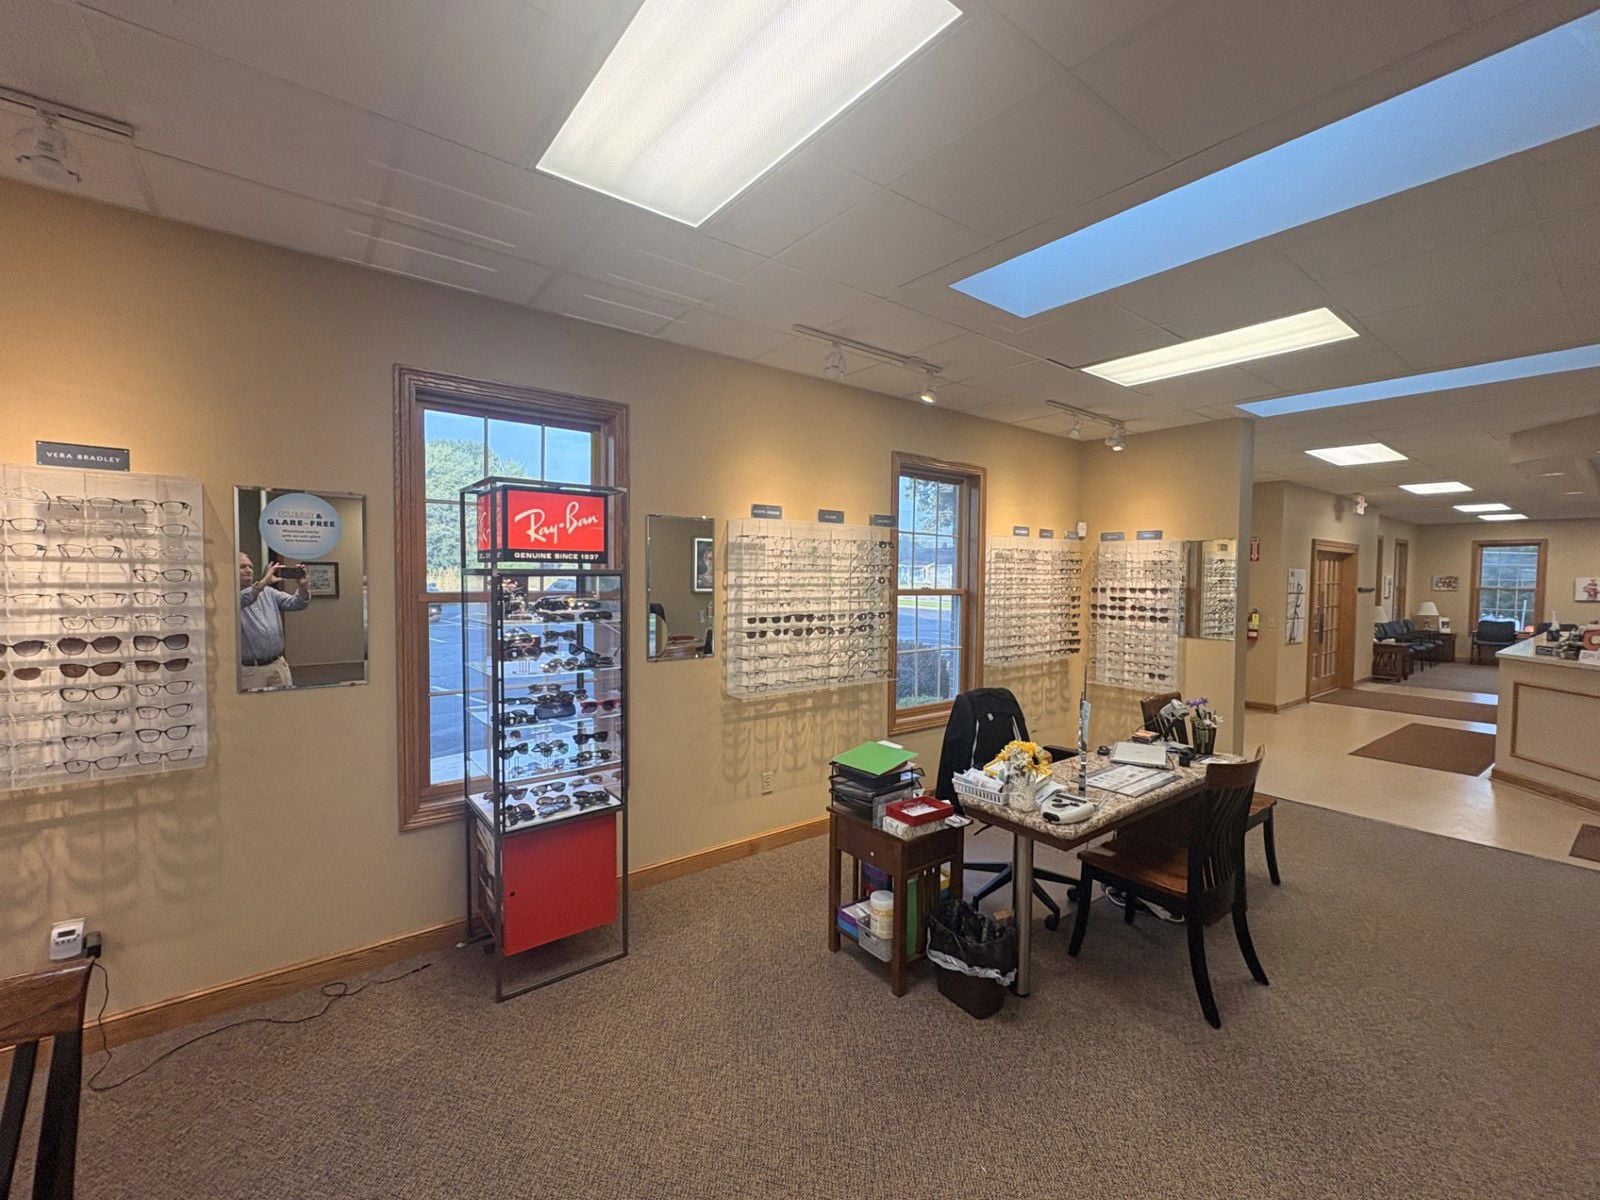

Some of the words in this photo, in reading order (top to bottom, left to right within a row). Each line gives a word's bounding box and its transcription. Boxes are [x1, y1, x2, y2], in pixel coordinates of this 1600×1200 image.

[46, 451, 73, 459] VERA
[77, 454, 121, 463] BRADLEY
[267, 518, 335, 527] GLARE-FREE
[514, 552, 552, 560] GENUINE
